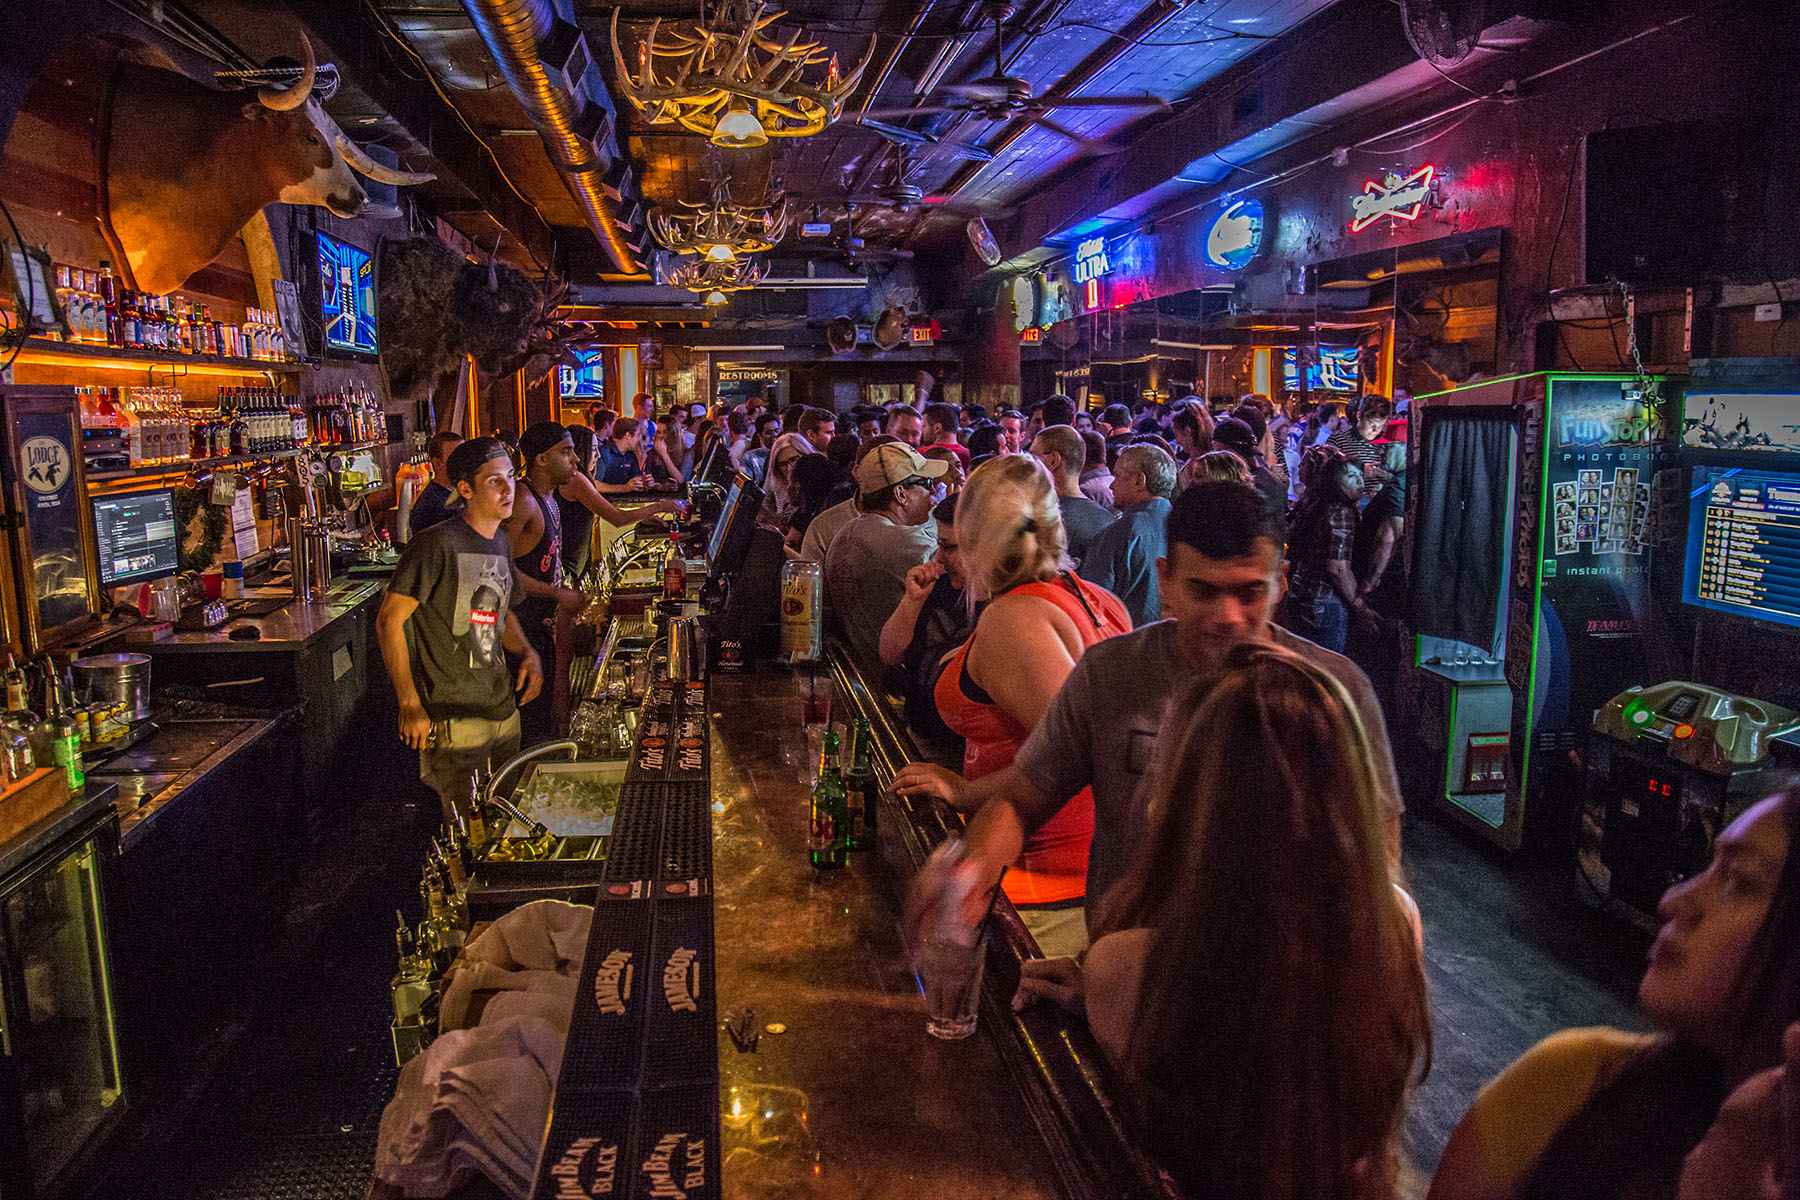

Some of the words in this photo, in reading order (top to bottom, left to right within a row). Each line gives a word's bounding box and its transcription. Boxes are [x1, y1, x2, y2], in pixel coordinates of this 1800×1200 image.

[1075, 254, 1109, 283] ULTRA
[913, 328, 931, 341] EXIT
[719, 372, 777, 381] RESTROOMS
[27, 445, 61, 467] LODGE
[720, 640, 742, 648] Tito's
[639, 748, 664, 771] Tito's
[678, 748, 702, 770] Tito's
[594, 949, 632, 1016] JAMESON
[663, 947, 697, 1012] JAMESON
[551, 1137, 601, 1175] BEAM
[642, 1133, 688, 1172] BEAM
[685, 1139, 705, 1189] BLACK
[592, 1145, 618, 1194] BLACK
[649, 1172, 687, 1200] JIM
